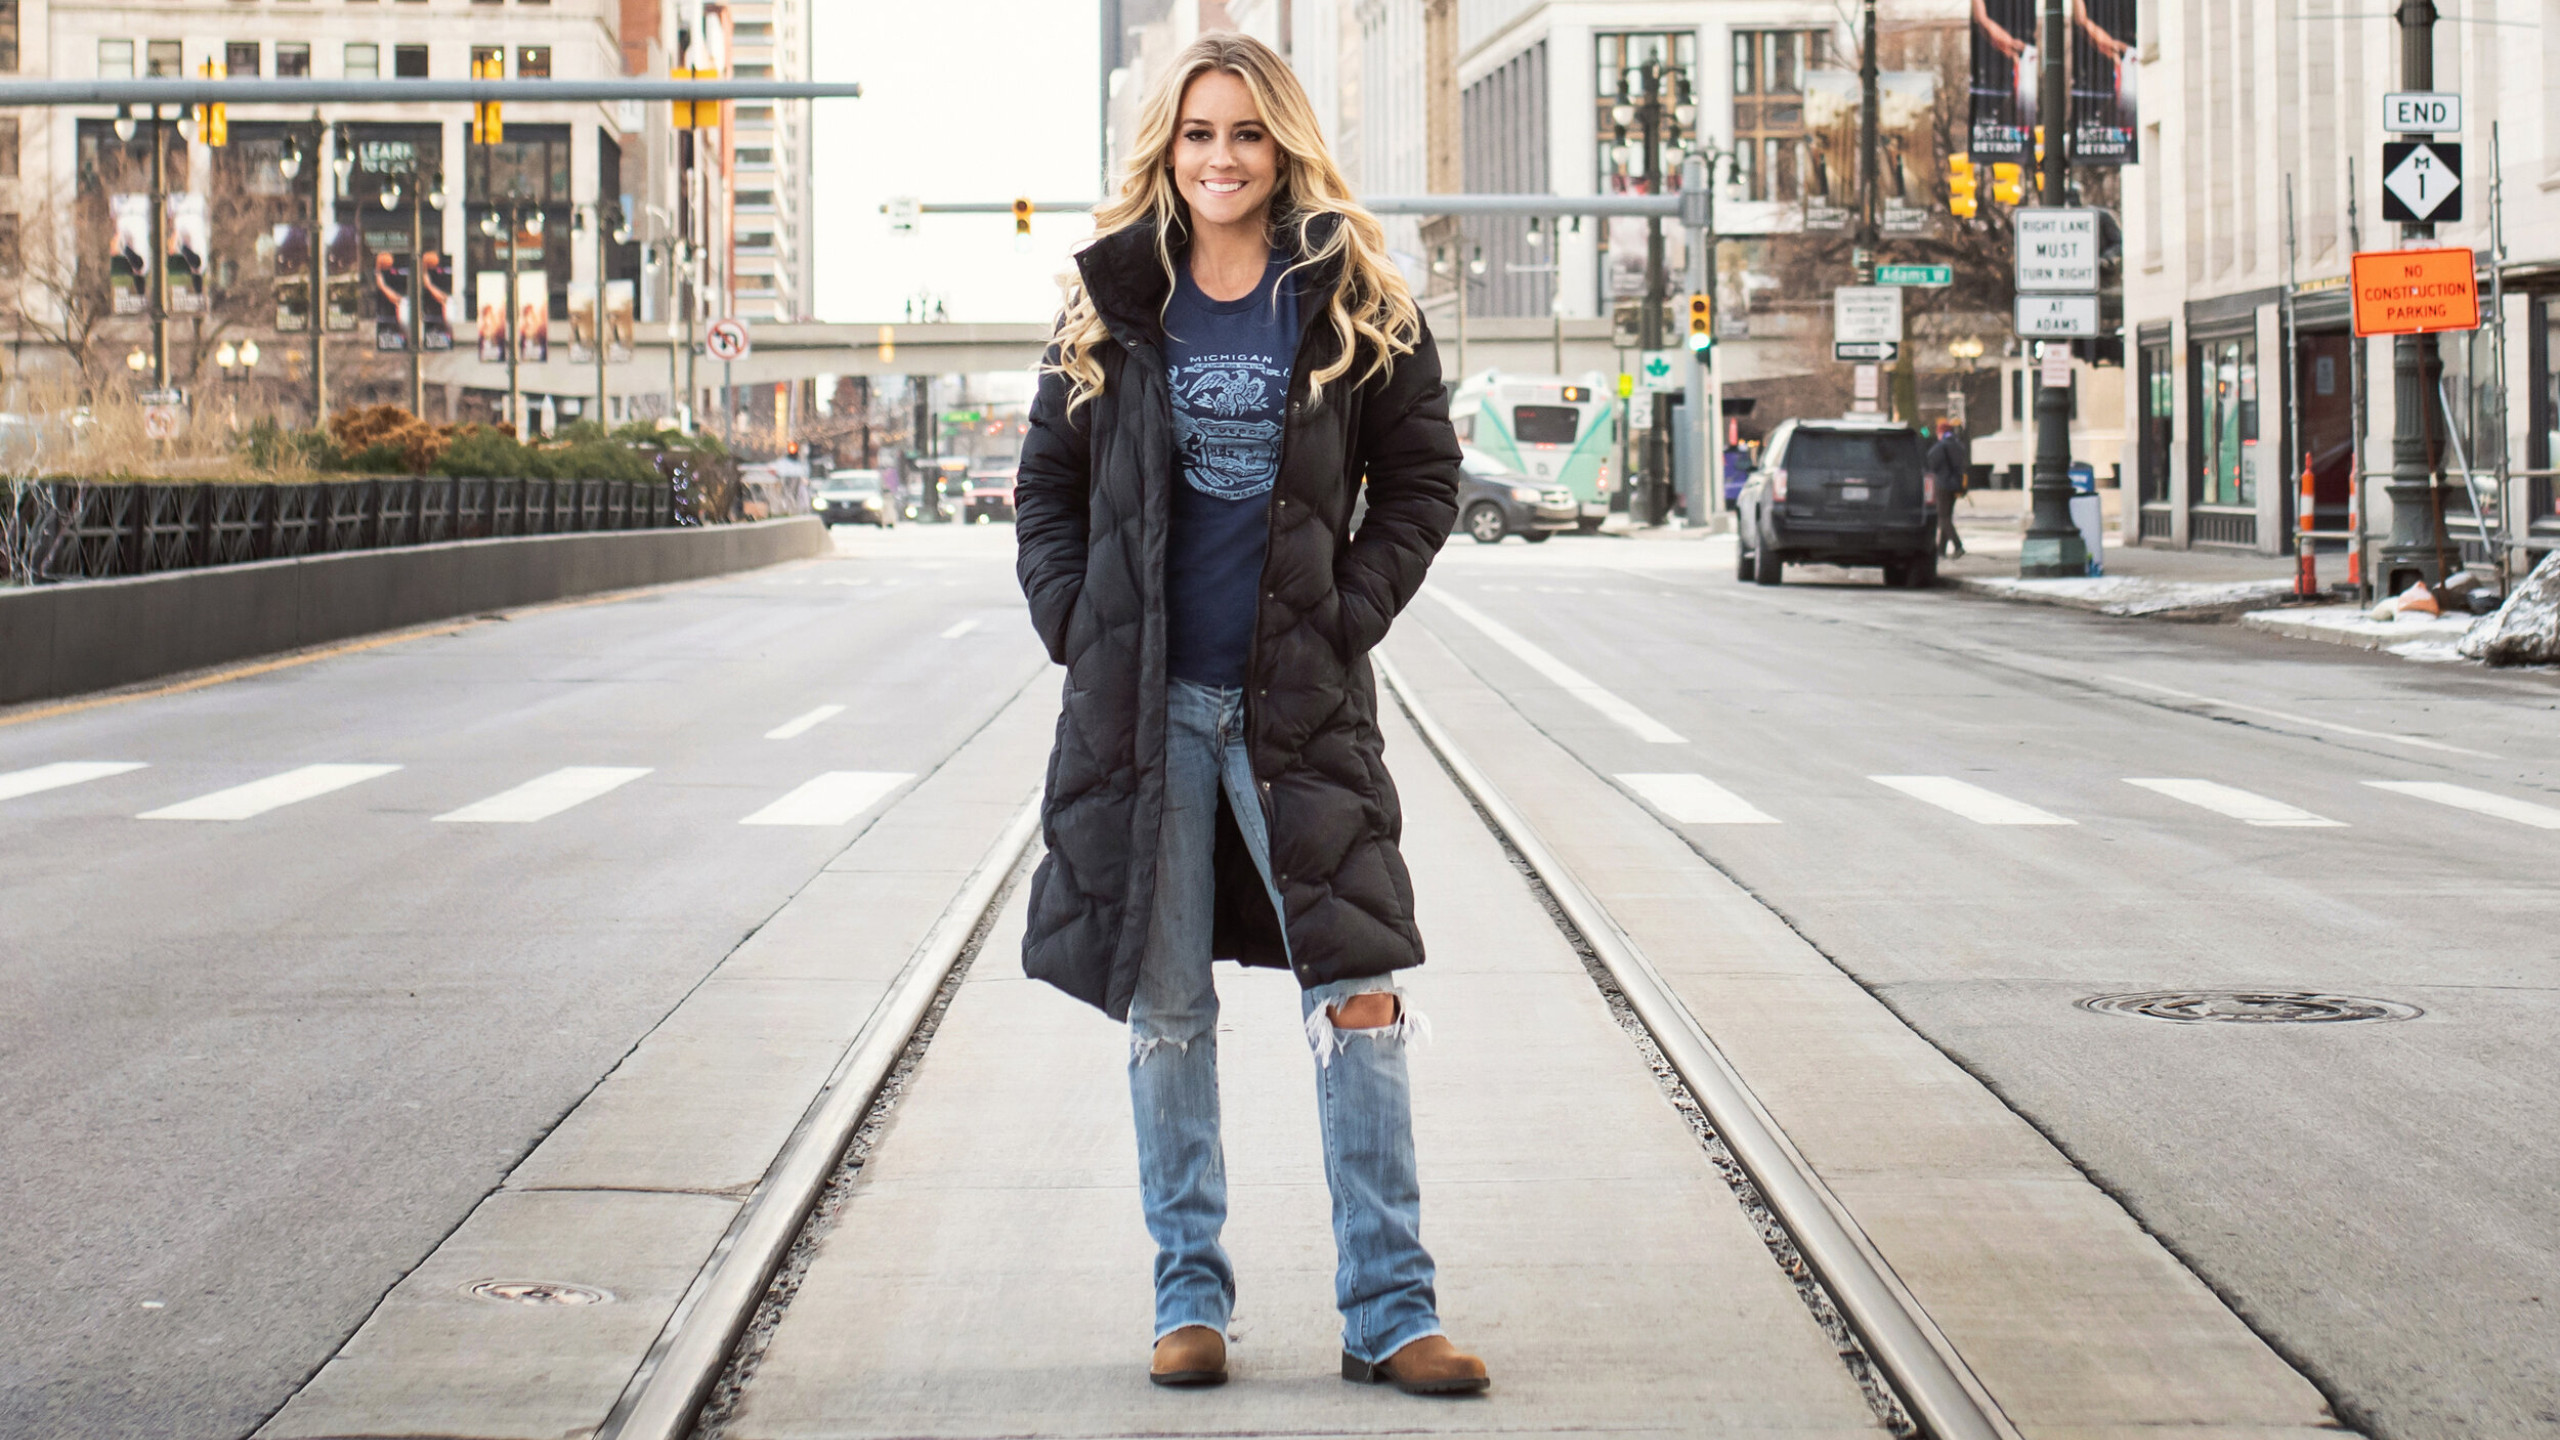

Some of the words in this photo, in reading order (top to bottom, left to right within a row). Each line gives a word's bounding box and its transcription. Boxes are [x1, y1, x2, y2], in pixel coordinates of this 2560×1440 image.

[2398, 102, 2447, 124] END
[2414, 156, 2431, 170] M
[2418, 173, 2425, 201] 1
[2022, 221, 2057, 233] RIGHT
[2060, 220, 2091, 233] LANE
[2036, 243, 2078, 258] MUST
[1881, 269, 1927, 281] Adams
[1932, 270, 1947, 280] W
[2022, 268, 2053, 280] TURN
[2058, 268, 2093, 280] RIGHT
[2404, 265, 2423, 279] NO
[2364, 283, 2467, 301] CONSTRUCTION
[2050, 301, 2064, 313] AT
[2387, 303, 2447, 320] PARKING
[2035, 319, 2079, 331] ADAMS
[1189, 354, 1273, 364] MICHIGAN
